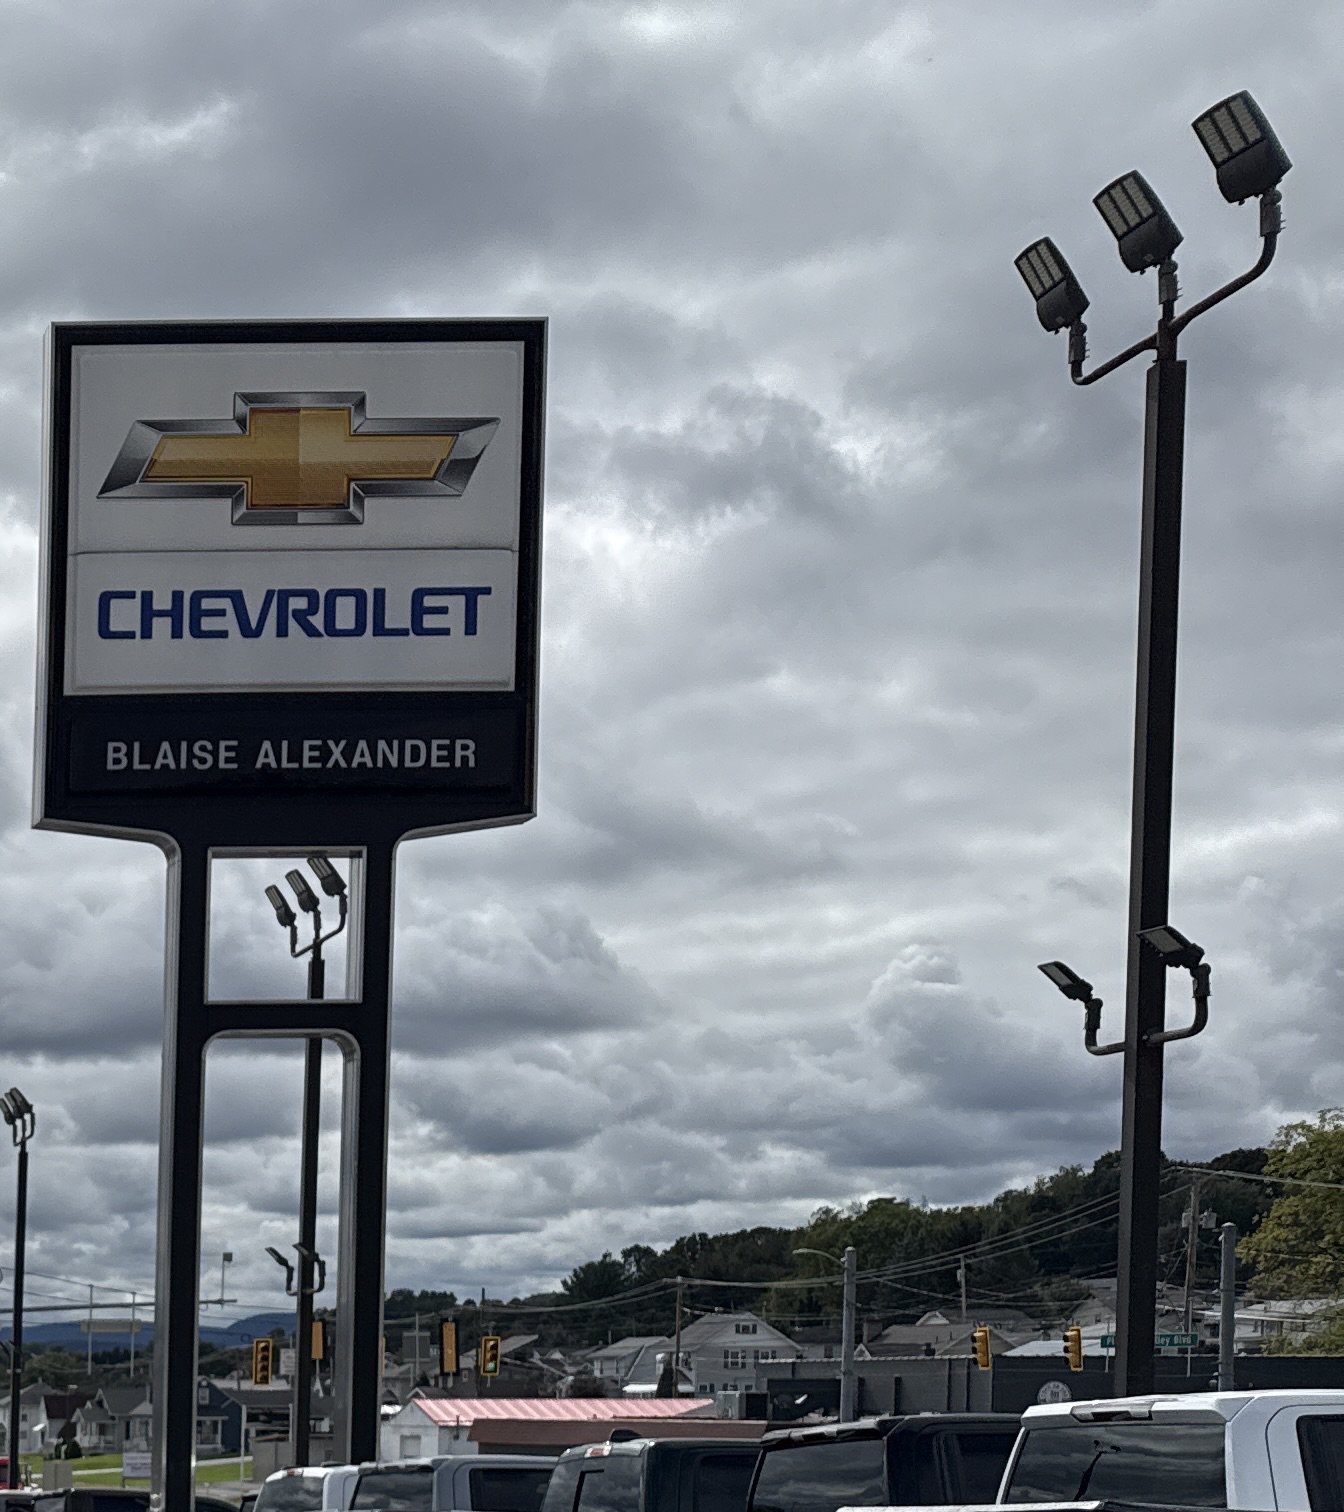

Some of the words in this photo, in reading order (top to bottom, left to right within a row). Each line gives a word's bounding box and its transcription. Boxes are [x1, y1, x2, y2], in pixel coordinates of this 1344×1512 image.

[97, 585, 492, 640] CHEVROLET
[105, 739, 239, 771] BLAISE
[254, 738, 477, 770] ALEXANDER
